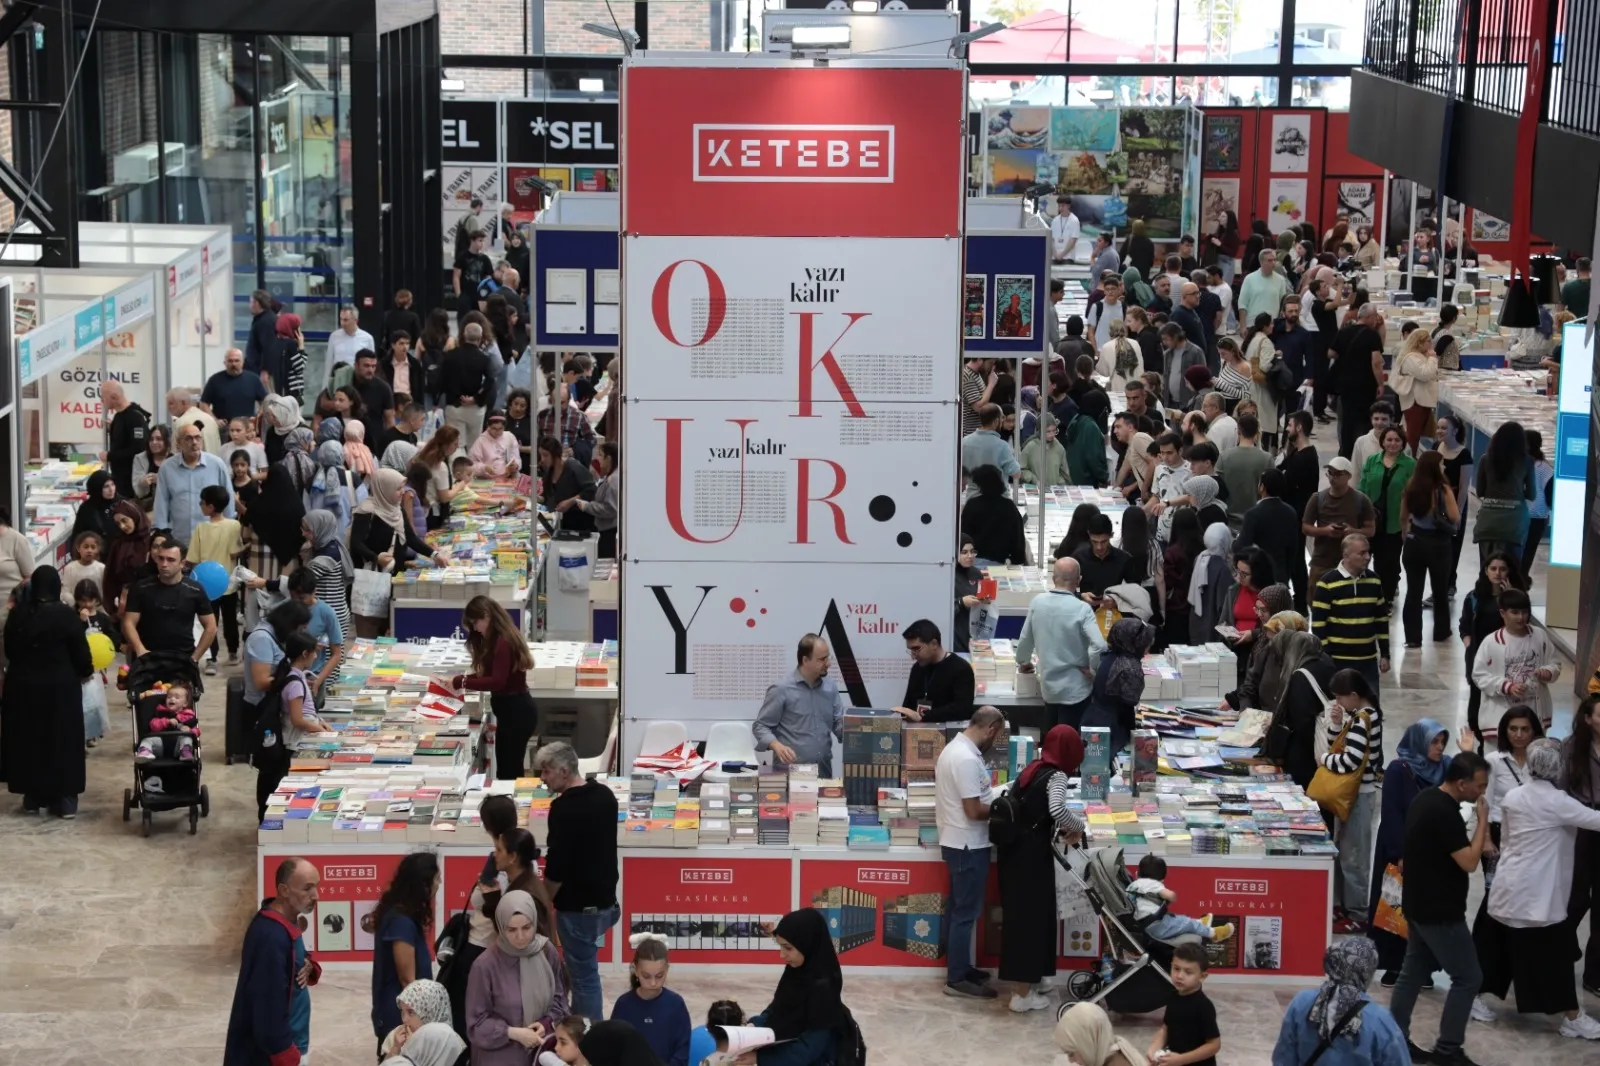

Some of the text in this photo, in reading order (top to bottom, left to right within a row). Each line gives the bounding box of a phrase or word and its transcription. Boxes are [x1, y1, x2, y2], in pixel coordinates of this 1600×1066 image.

[708, 139, 880, 168] KETEBE
[804, 267, 845, 285] yazı
[790, 282, 840, 303] kalır
[651, 259, 727, 347] O
[788, 312, 876, 418] K
[708, 438, 787, 463] yazı kalır
[653, 418, 759, 543] U
[787, 458, 857, 544] R
[846, 602, 878, 619] yazı
[643, 585, 718, 675] Y
[857, 617, 900, 634] kalır
[818, 598, 872, 709] A
[327, 868, 374, 877] KETEBE
[684, 871, 730, 880] KETEBE
[861, 871, 906, 881] KETEBE
[319, 886, 382, 895] YŞE ŞAS
[1218, 882, 1265, 892] KETEBE
[665, 894, 749, 902] KLASİKLER
[1199, 899, 1284, 909] BİYOGRAFİ
